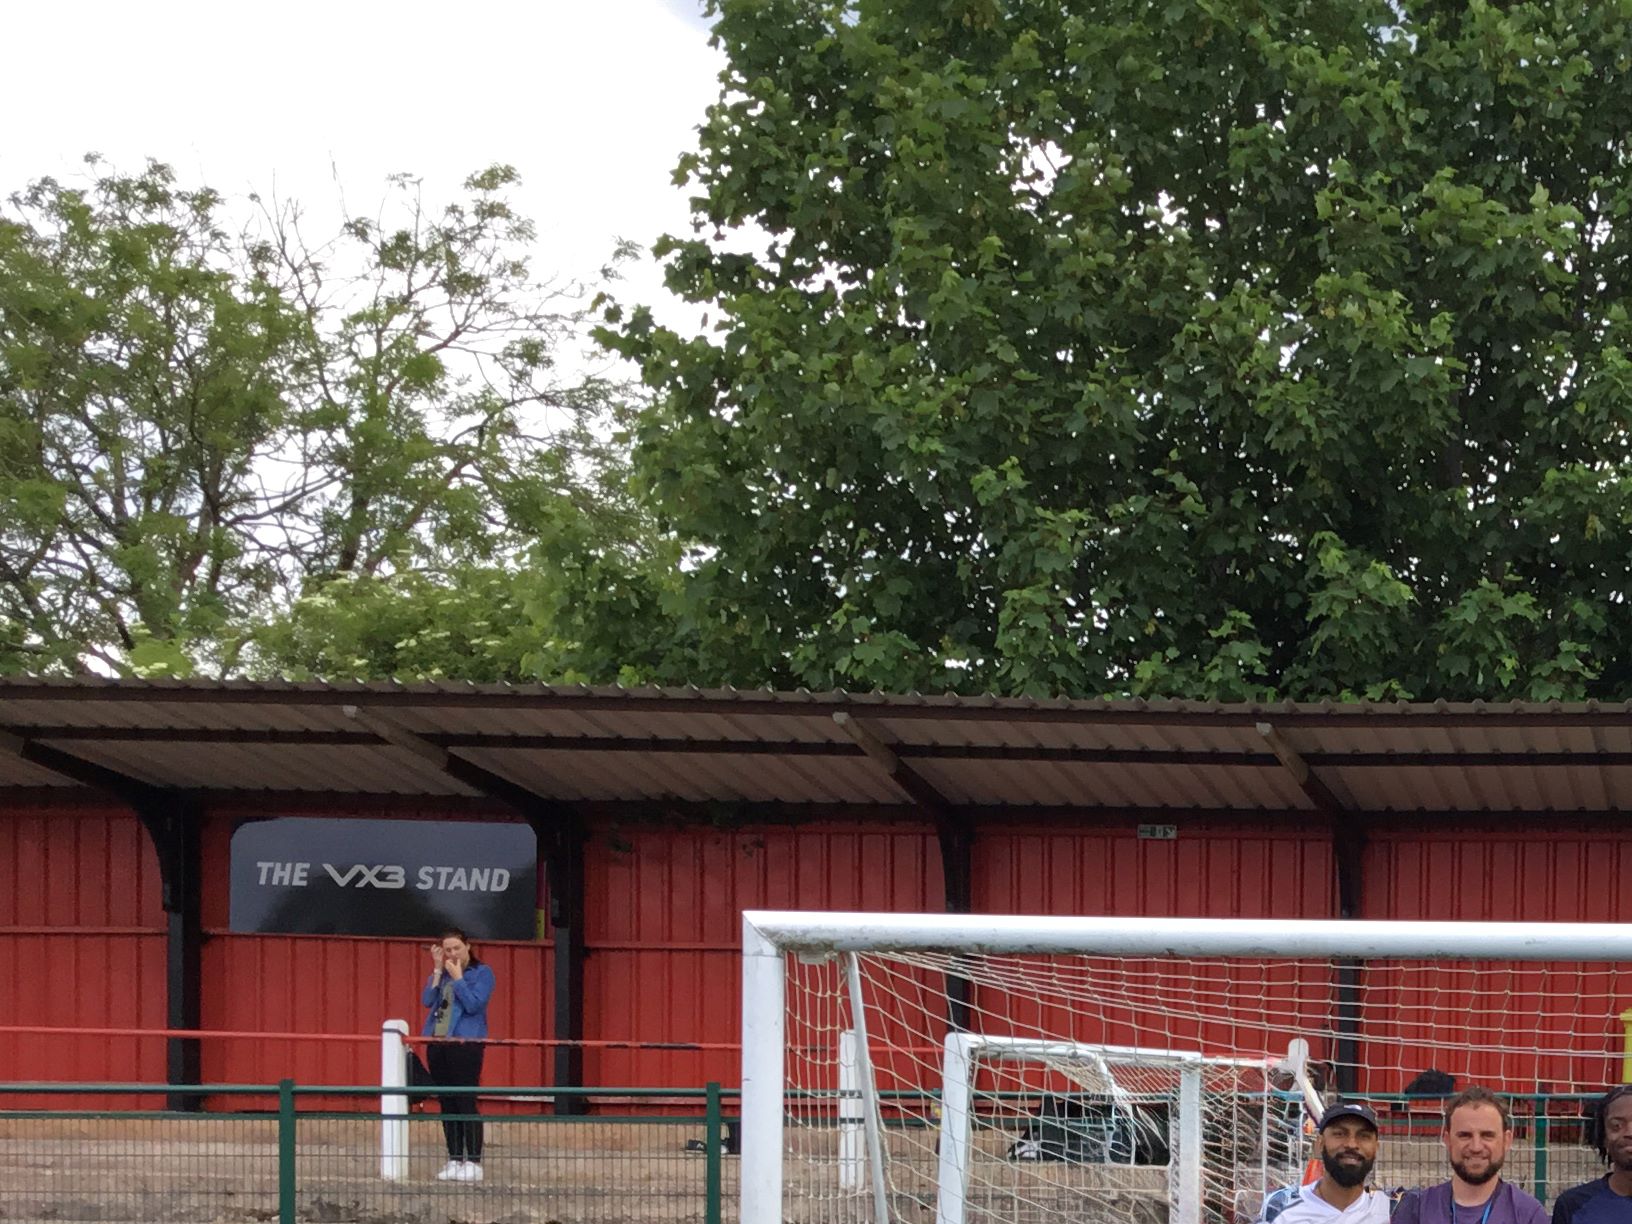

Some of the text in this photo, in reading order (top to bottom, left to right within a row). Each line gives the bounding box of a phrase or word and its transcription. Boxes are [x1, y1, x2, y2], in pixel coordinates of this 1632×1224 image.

[256, 861, 511, 892] THE VX3 STAND
